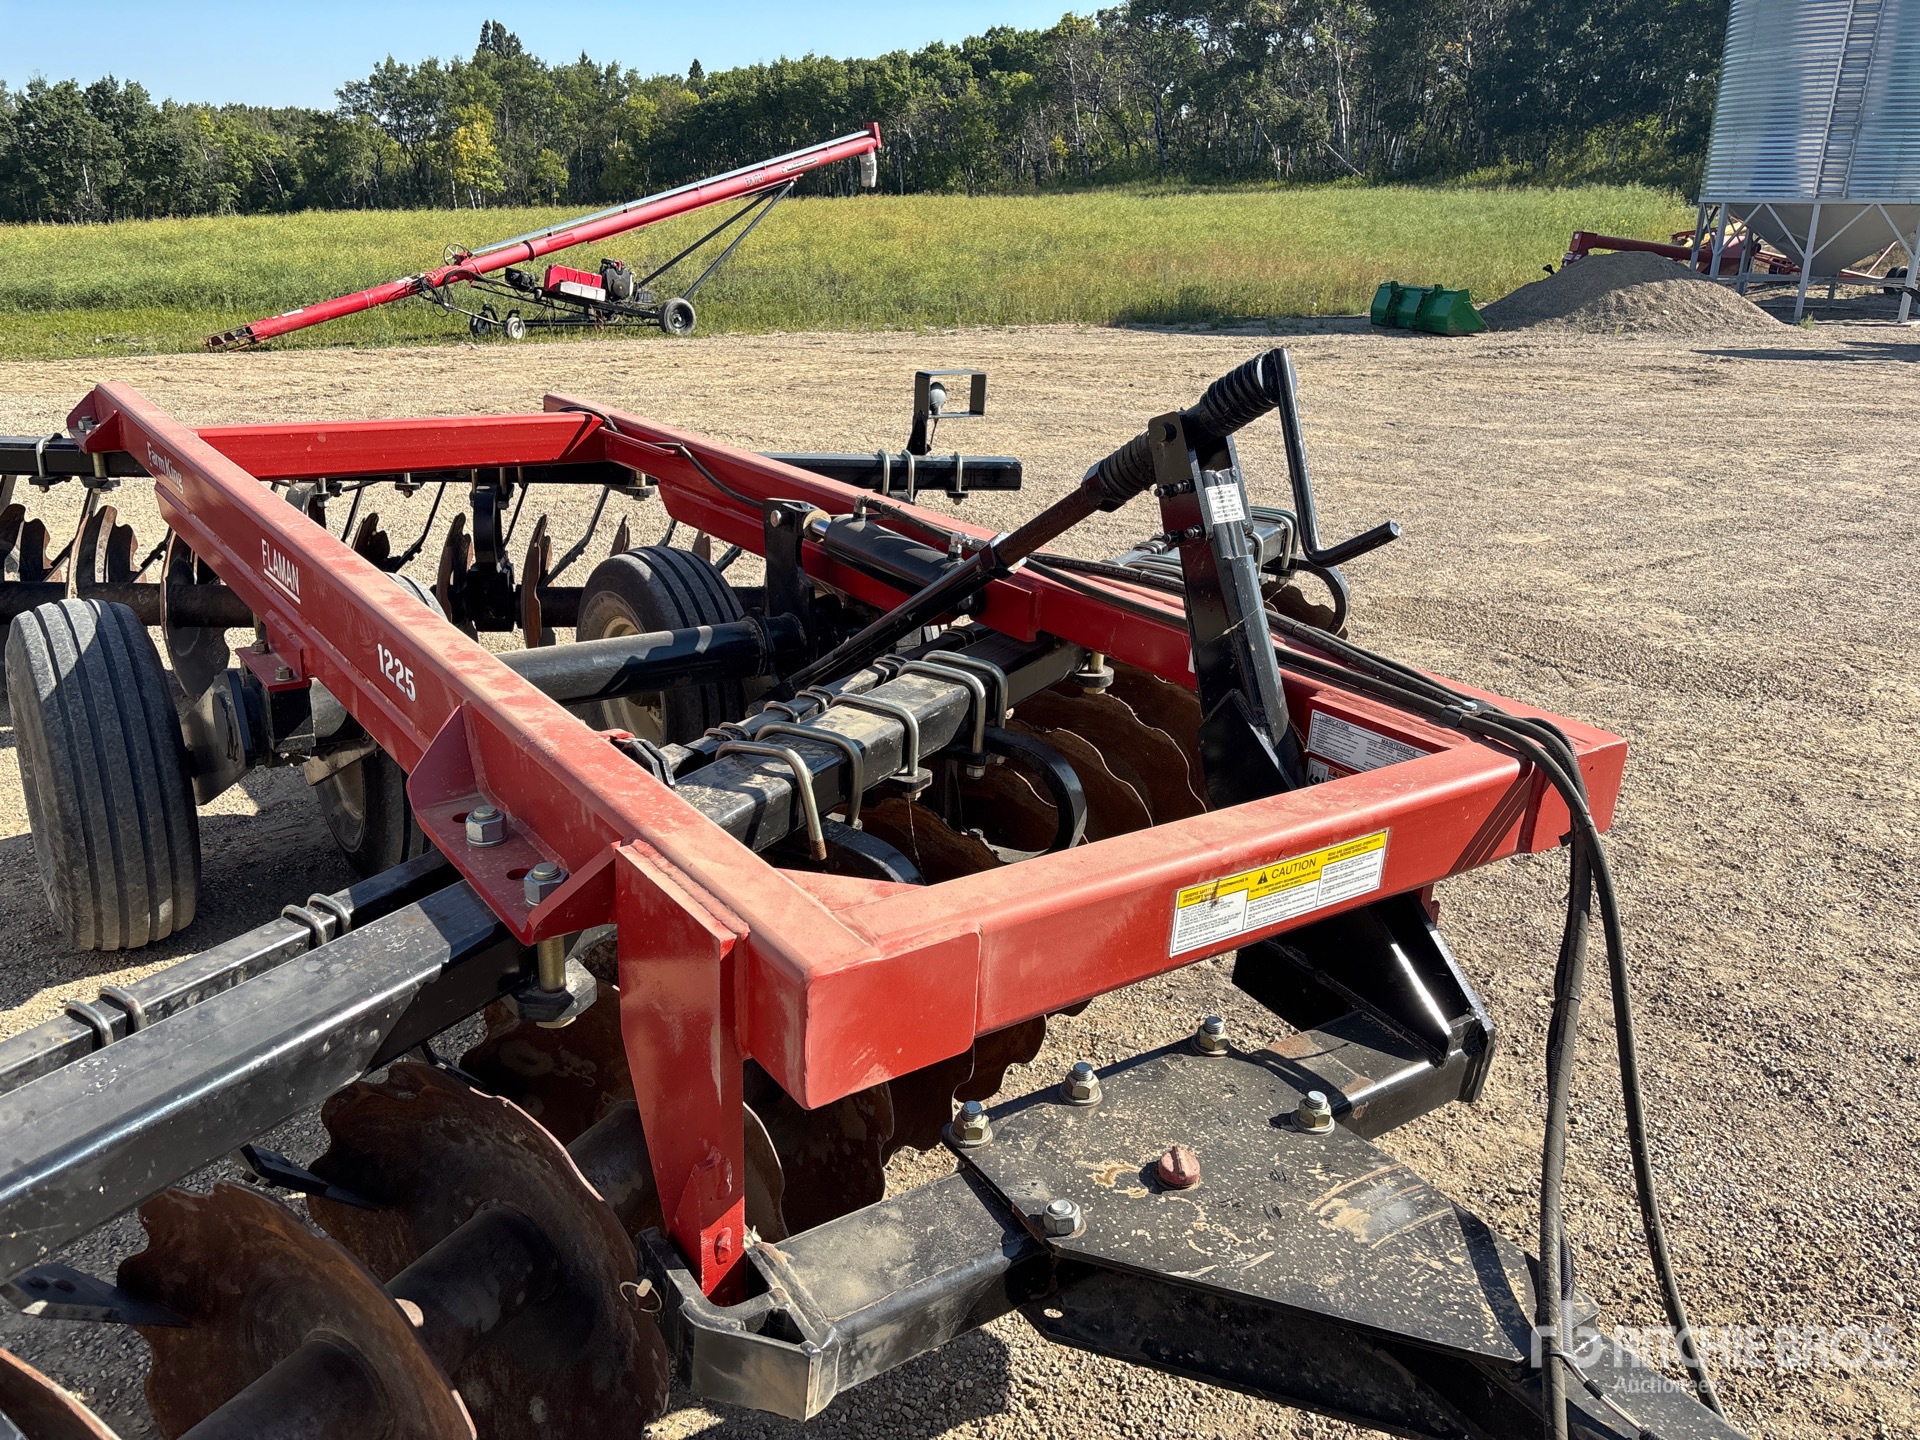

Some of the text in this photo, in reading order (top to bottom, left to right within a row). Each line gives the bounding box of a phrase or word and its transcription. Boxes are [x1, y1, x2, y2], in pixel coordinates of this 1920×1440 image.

[262, 538, 300, 596] FLAMAN
[378, 644, 416, 702] 1225
[1318, 715, 1350, 731] LUBRICATION
[1380, 738, 1418, 756] MAINTENANCE
[1272, 858, 1316, 879] CAUTION
